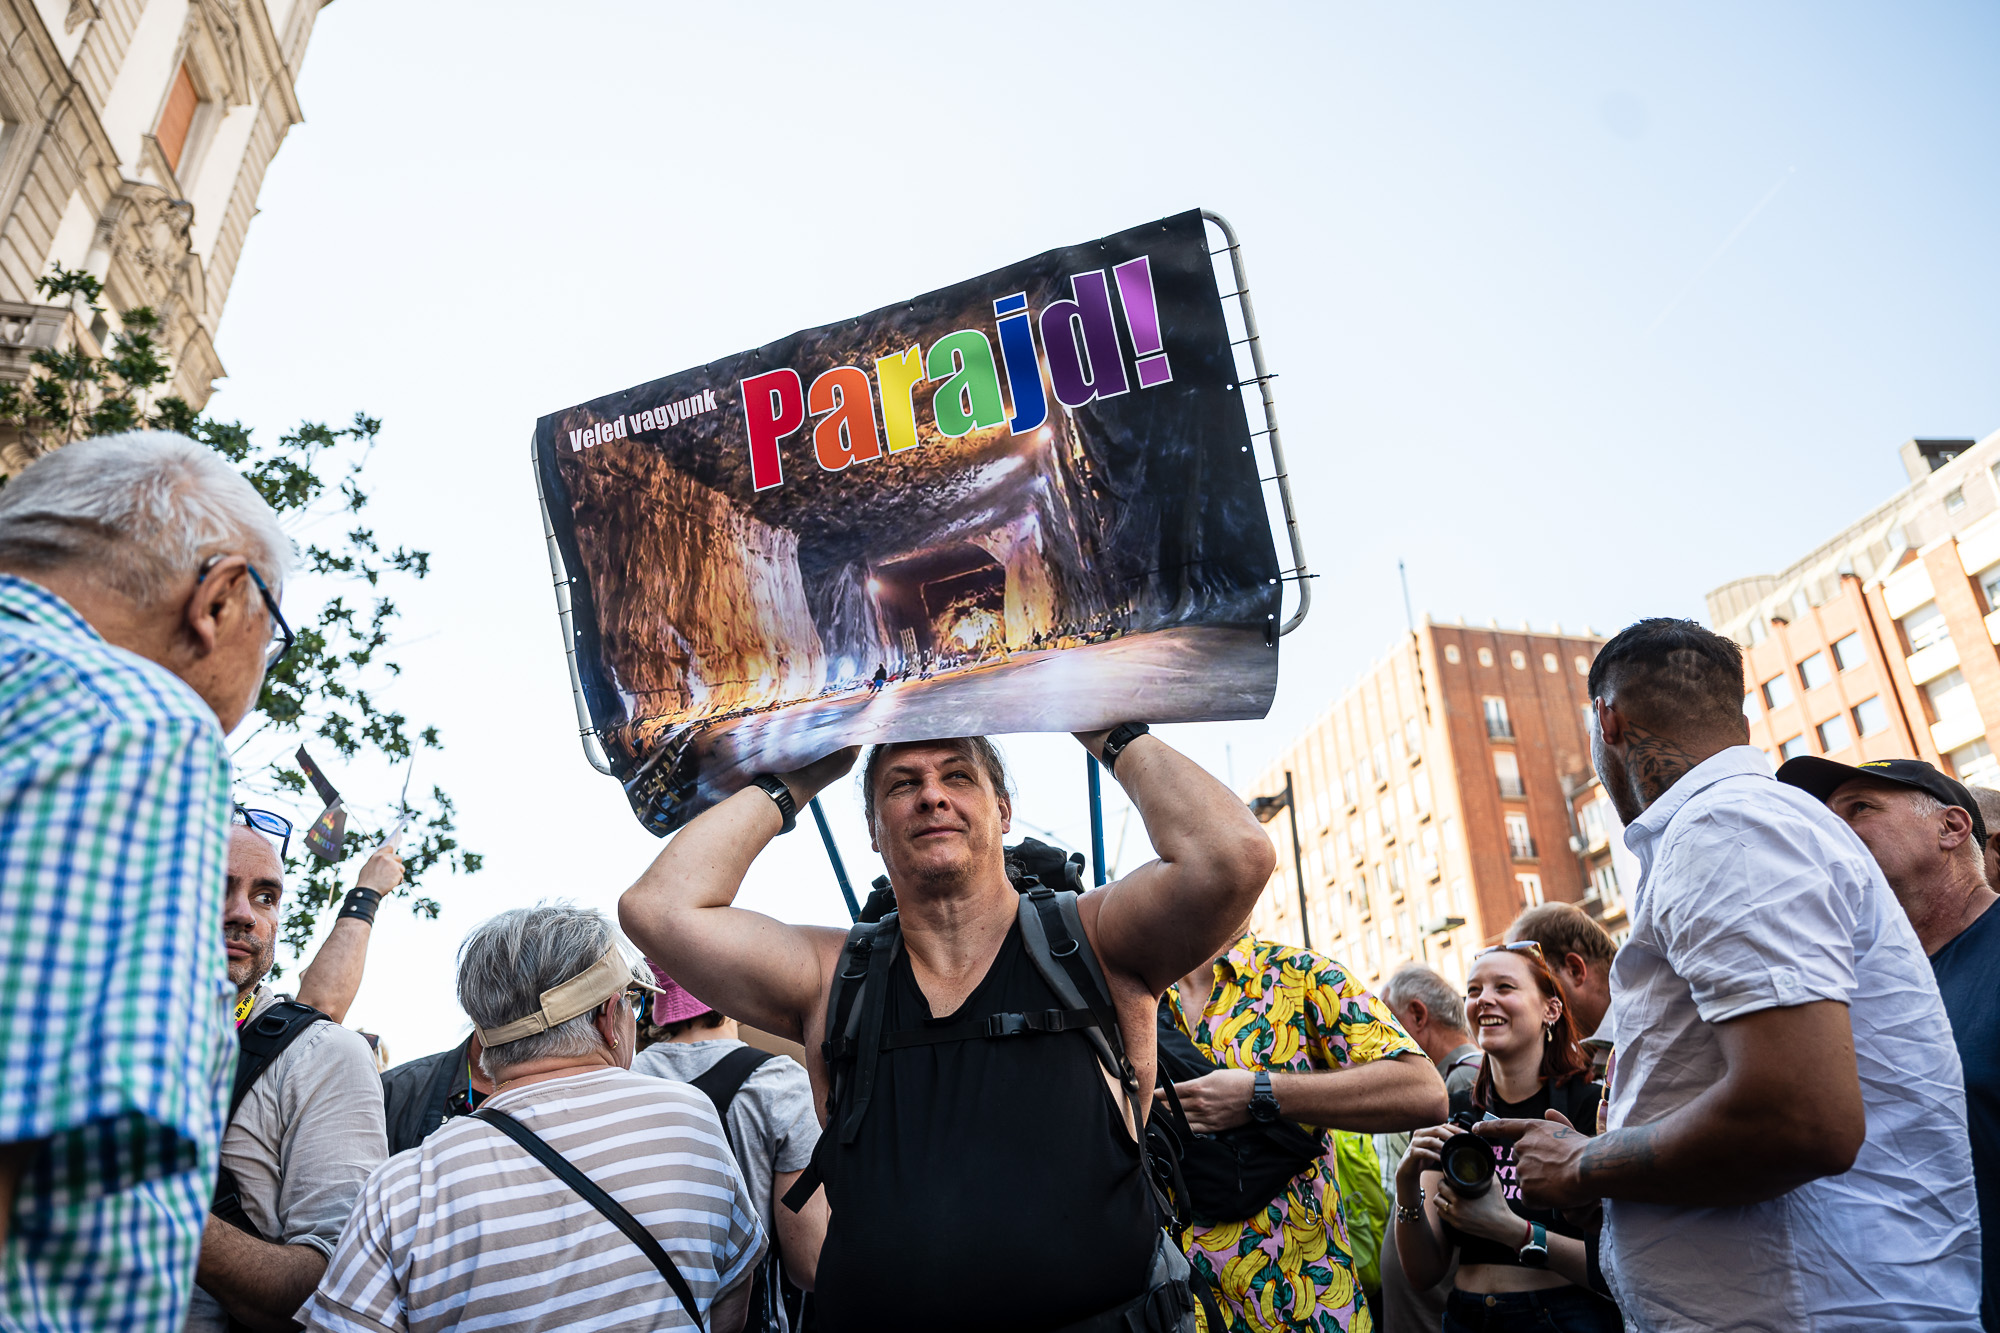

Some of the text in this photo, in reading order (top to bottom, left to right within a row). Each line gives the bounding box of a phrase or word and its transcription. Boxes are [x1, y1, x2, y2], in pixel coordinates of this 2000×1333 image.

[569, 388, 718, 453] Veled vagyunk
[740, 255, 1173, 492] Parajd!
